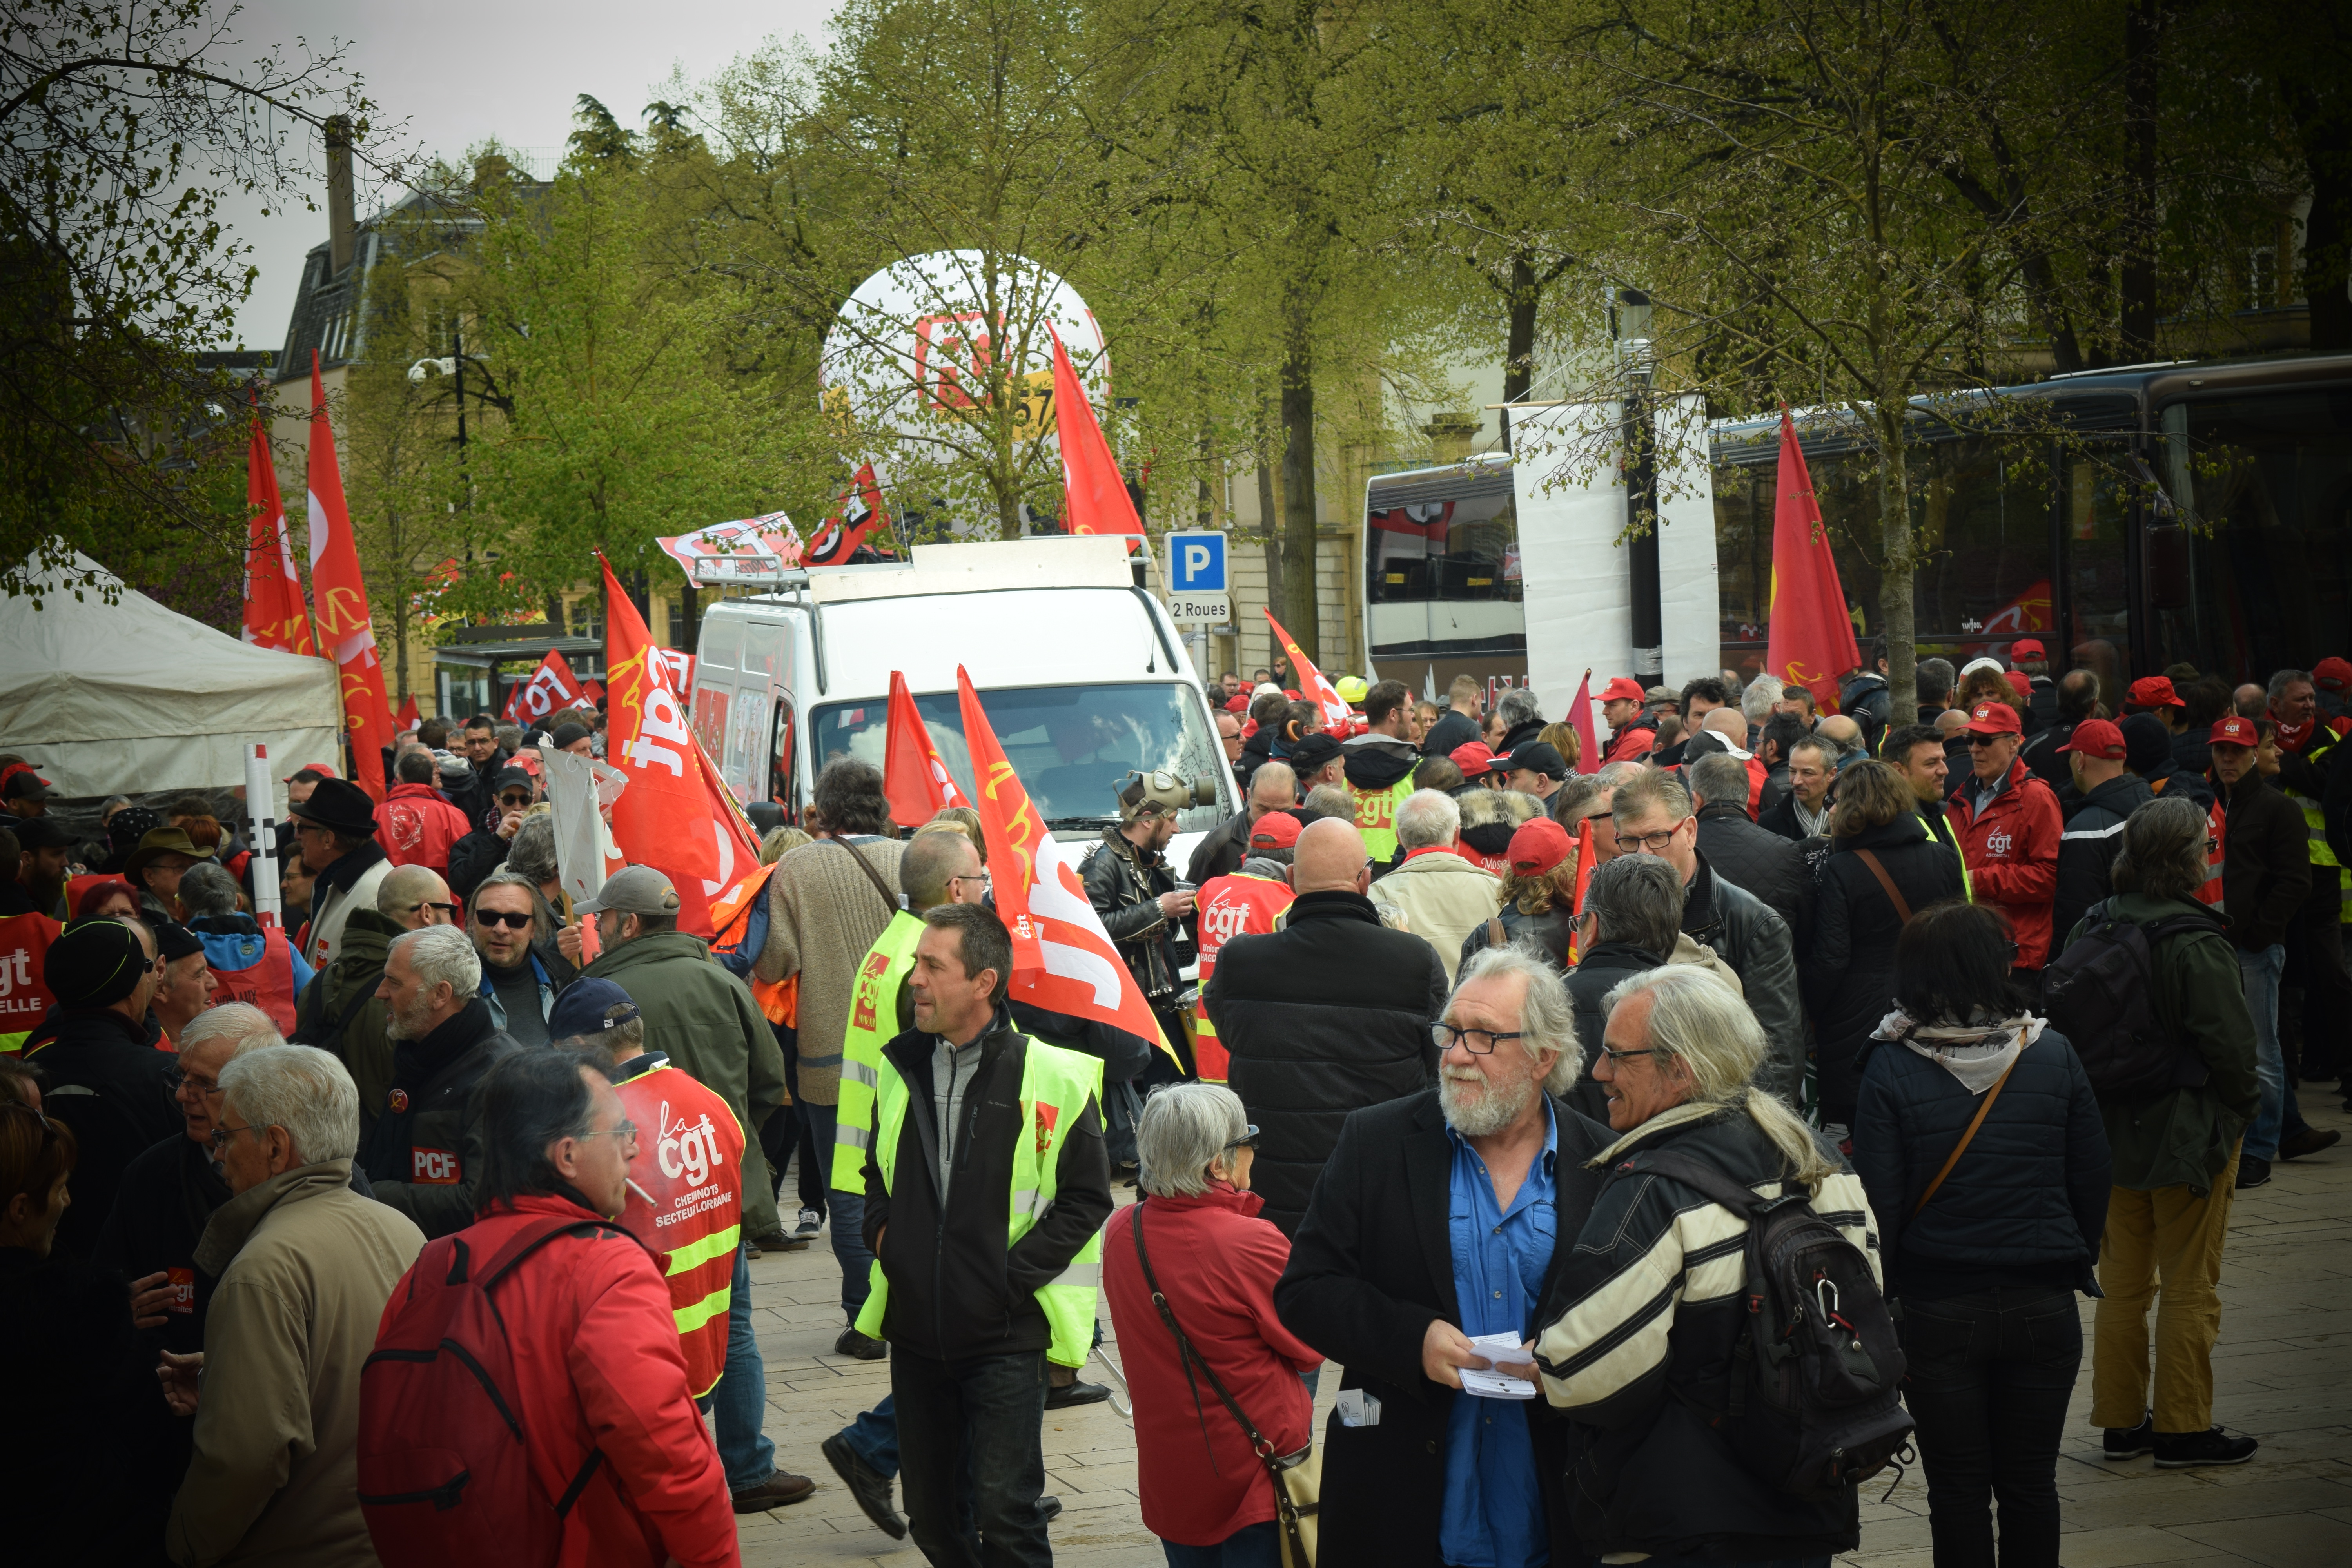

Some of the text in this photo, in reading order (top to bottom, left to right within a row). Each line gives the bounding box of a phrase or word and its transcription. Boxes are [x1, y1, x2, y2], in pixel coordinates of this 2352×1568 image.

[1185, 545, 1210, 582] P
[1173, 602, 1226, 617] 2 Roues
[1976, 710, 1989, 718] cgt
[1353, 790, 1393, 825] cgt
[1987, 835, 2012, 853] cgt
[1207, 887, 1250, 909] la
[1016, 914, 1031, 938] cgt
[1204, 902, 1250, 945] cgt
[657, 1100, 710, 1145] la
[658, 1113, 723, 1187] cgt
[415, 1151, 456, 1178] PCF
[655, 1204, 696, 1227] SECTEUR
